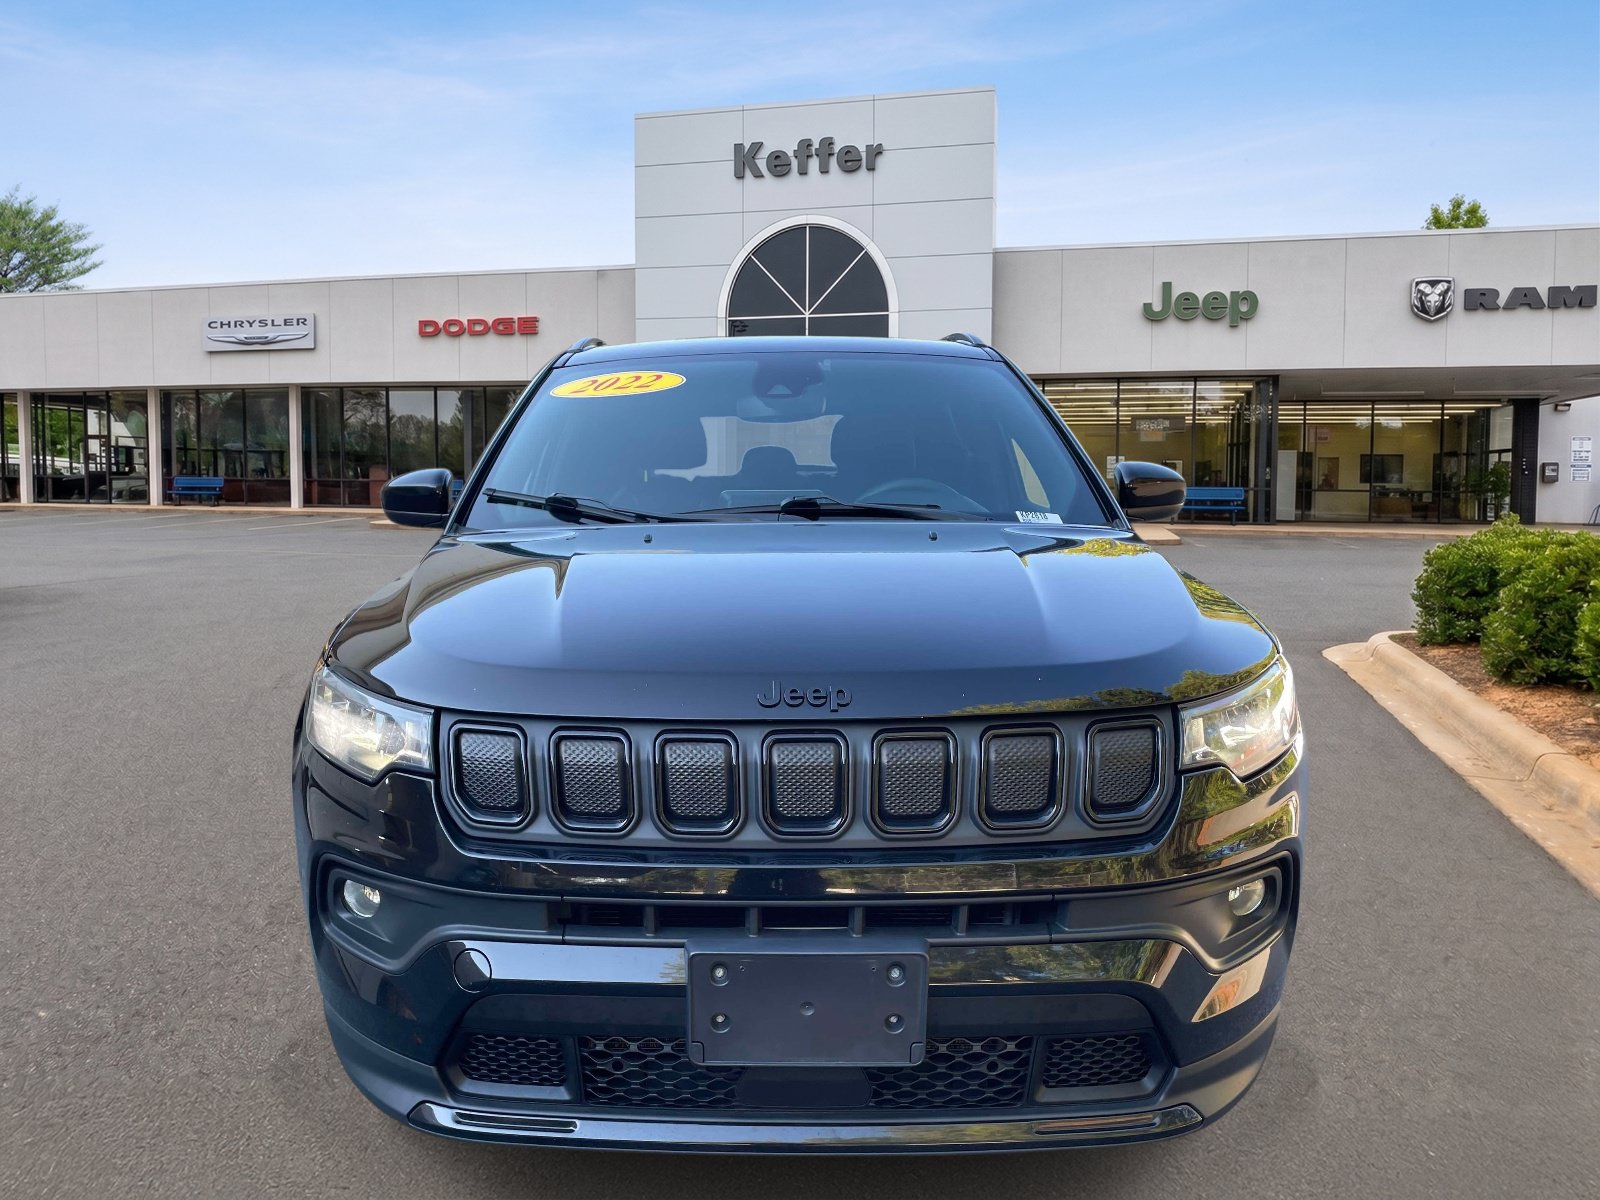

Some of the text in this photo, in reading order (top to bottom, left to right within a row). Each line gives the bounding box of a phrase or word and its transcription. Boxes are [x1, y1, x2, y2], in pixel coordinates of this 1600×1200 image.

[734, 137, 883, 178] Keffer
[1143, 281, 1259, 328] Jeep
[1464, 285, 1598, 310] RAM
[207, 317, 308, 330] CHRYSLER
[418, 317, 539, 337] DODGE
[569, 374, 663, 394] 2022
[757, 680, 852, 712] Jeep
